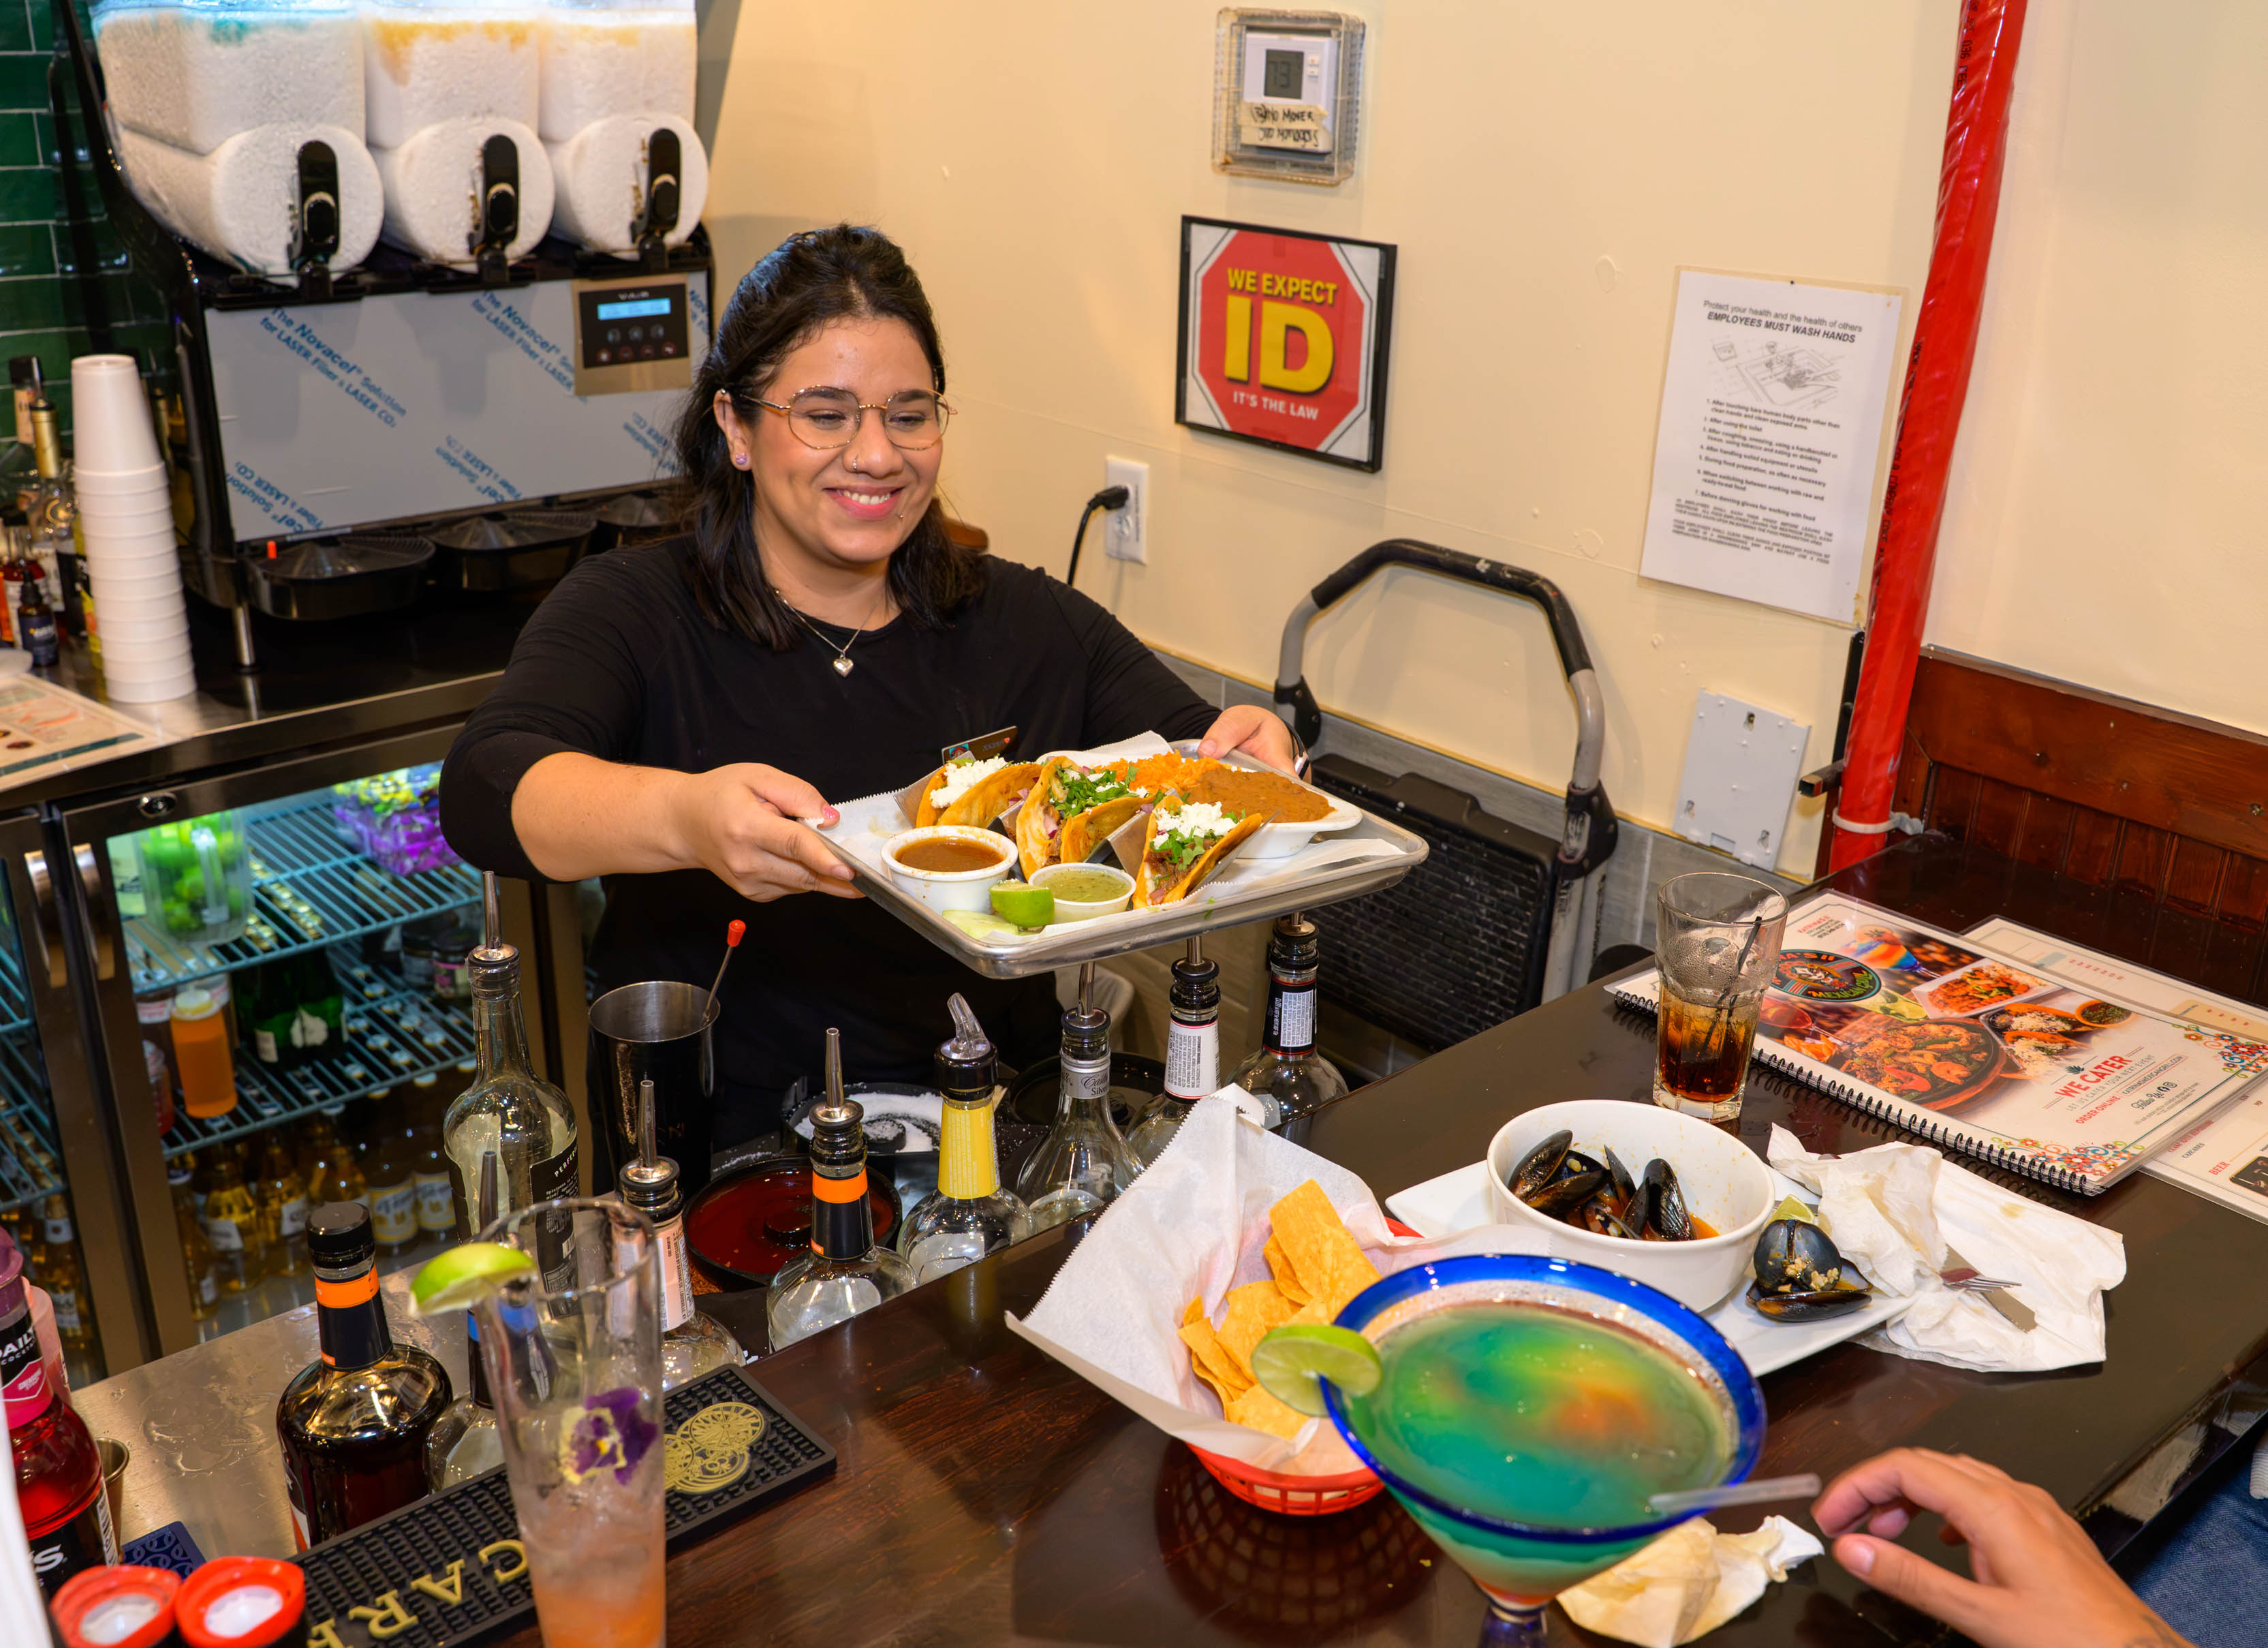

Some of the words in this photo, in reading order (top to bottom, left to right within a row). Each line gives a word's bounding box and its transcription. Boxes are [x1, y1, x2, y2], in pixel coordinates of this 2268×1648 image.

[1227, 267, 1258, 293] WE
[1261, 273, 1338, 306] EXPECT
[1703, 300, 1729, 311] Protect
[1730, 305, 1746, 315] your
[1748, 307, 1772, 317] health
[1773, 311, 1788, 320] and
[1788, 313, 1802, 322] the
[1803, 315, 1827, 326] health
[1829, 320, 1837, 328] of
[1837, 321, 1863, 332] others
[1707, 311, 1762, 328] EMPLOYEES
[1764, 320, 1790, 333] MUST
[1791, 324, 1820, 338] WASH
[1822, 329, 1856, 343] HANDS
[1224, 294, 1335, 395] ID
[261, 317, 278, 332] for
[277, 331, 311, 359] LASER
[346, 385, 377, 410] LASER
[1233, 390, 1258, 407] IT'S
[1262, 397, 1286, 413] THE
[1290, 403, 1318, 420] LAW
[1782, 412, 1796, 421] body
[1812, 418, 1827, 426] other
[255, 478, 288, 504] LASER
[2055, 1081, 2090, 1098] WE
[2080, 1055, 2133, 1084] CATER
[2066, 1102, 2077, 1112] LET
[2078, 1097, 2087, 1106] US
[2086, 1085, 2107, 1100] CATER
[2104, 1075, 2122, 1089] YOUR
[2121, 1065, 2139, 1079] NEXT
[2136, 1055, 2156, 1070] EVENT
[2075, 1109, 2098, 1123] ORDER
[2095, 1095, 2121, 1112] ONLINE
[2131, 1093, 2156, 1110] Follow
[2208, 1161, 2230, 1175] BEER
